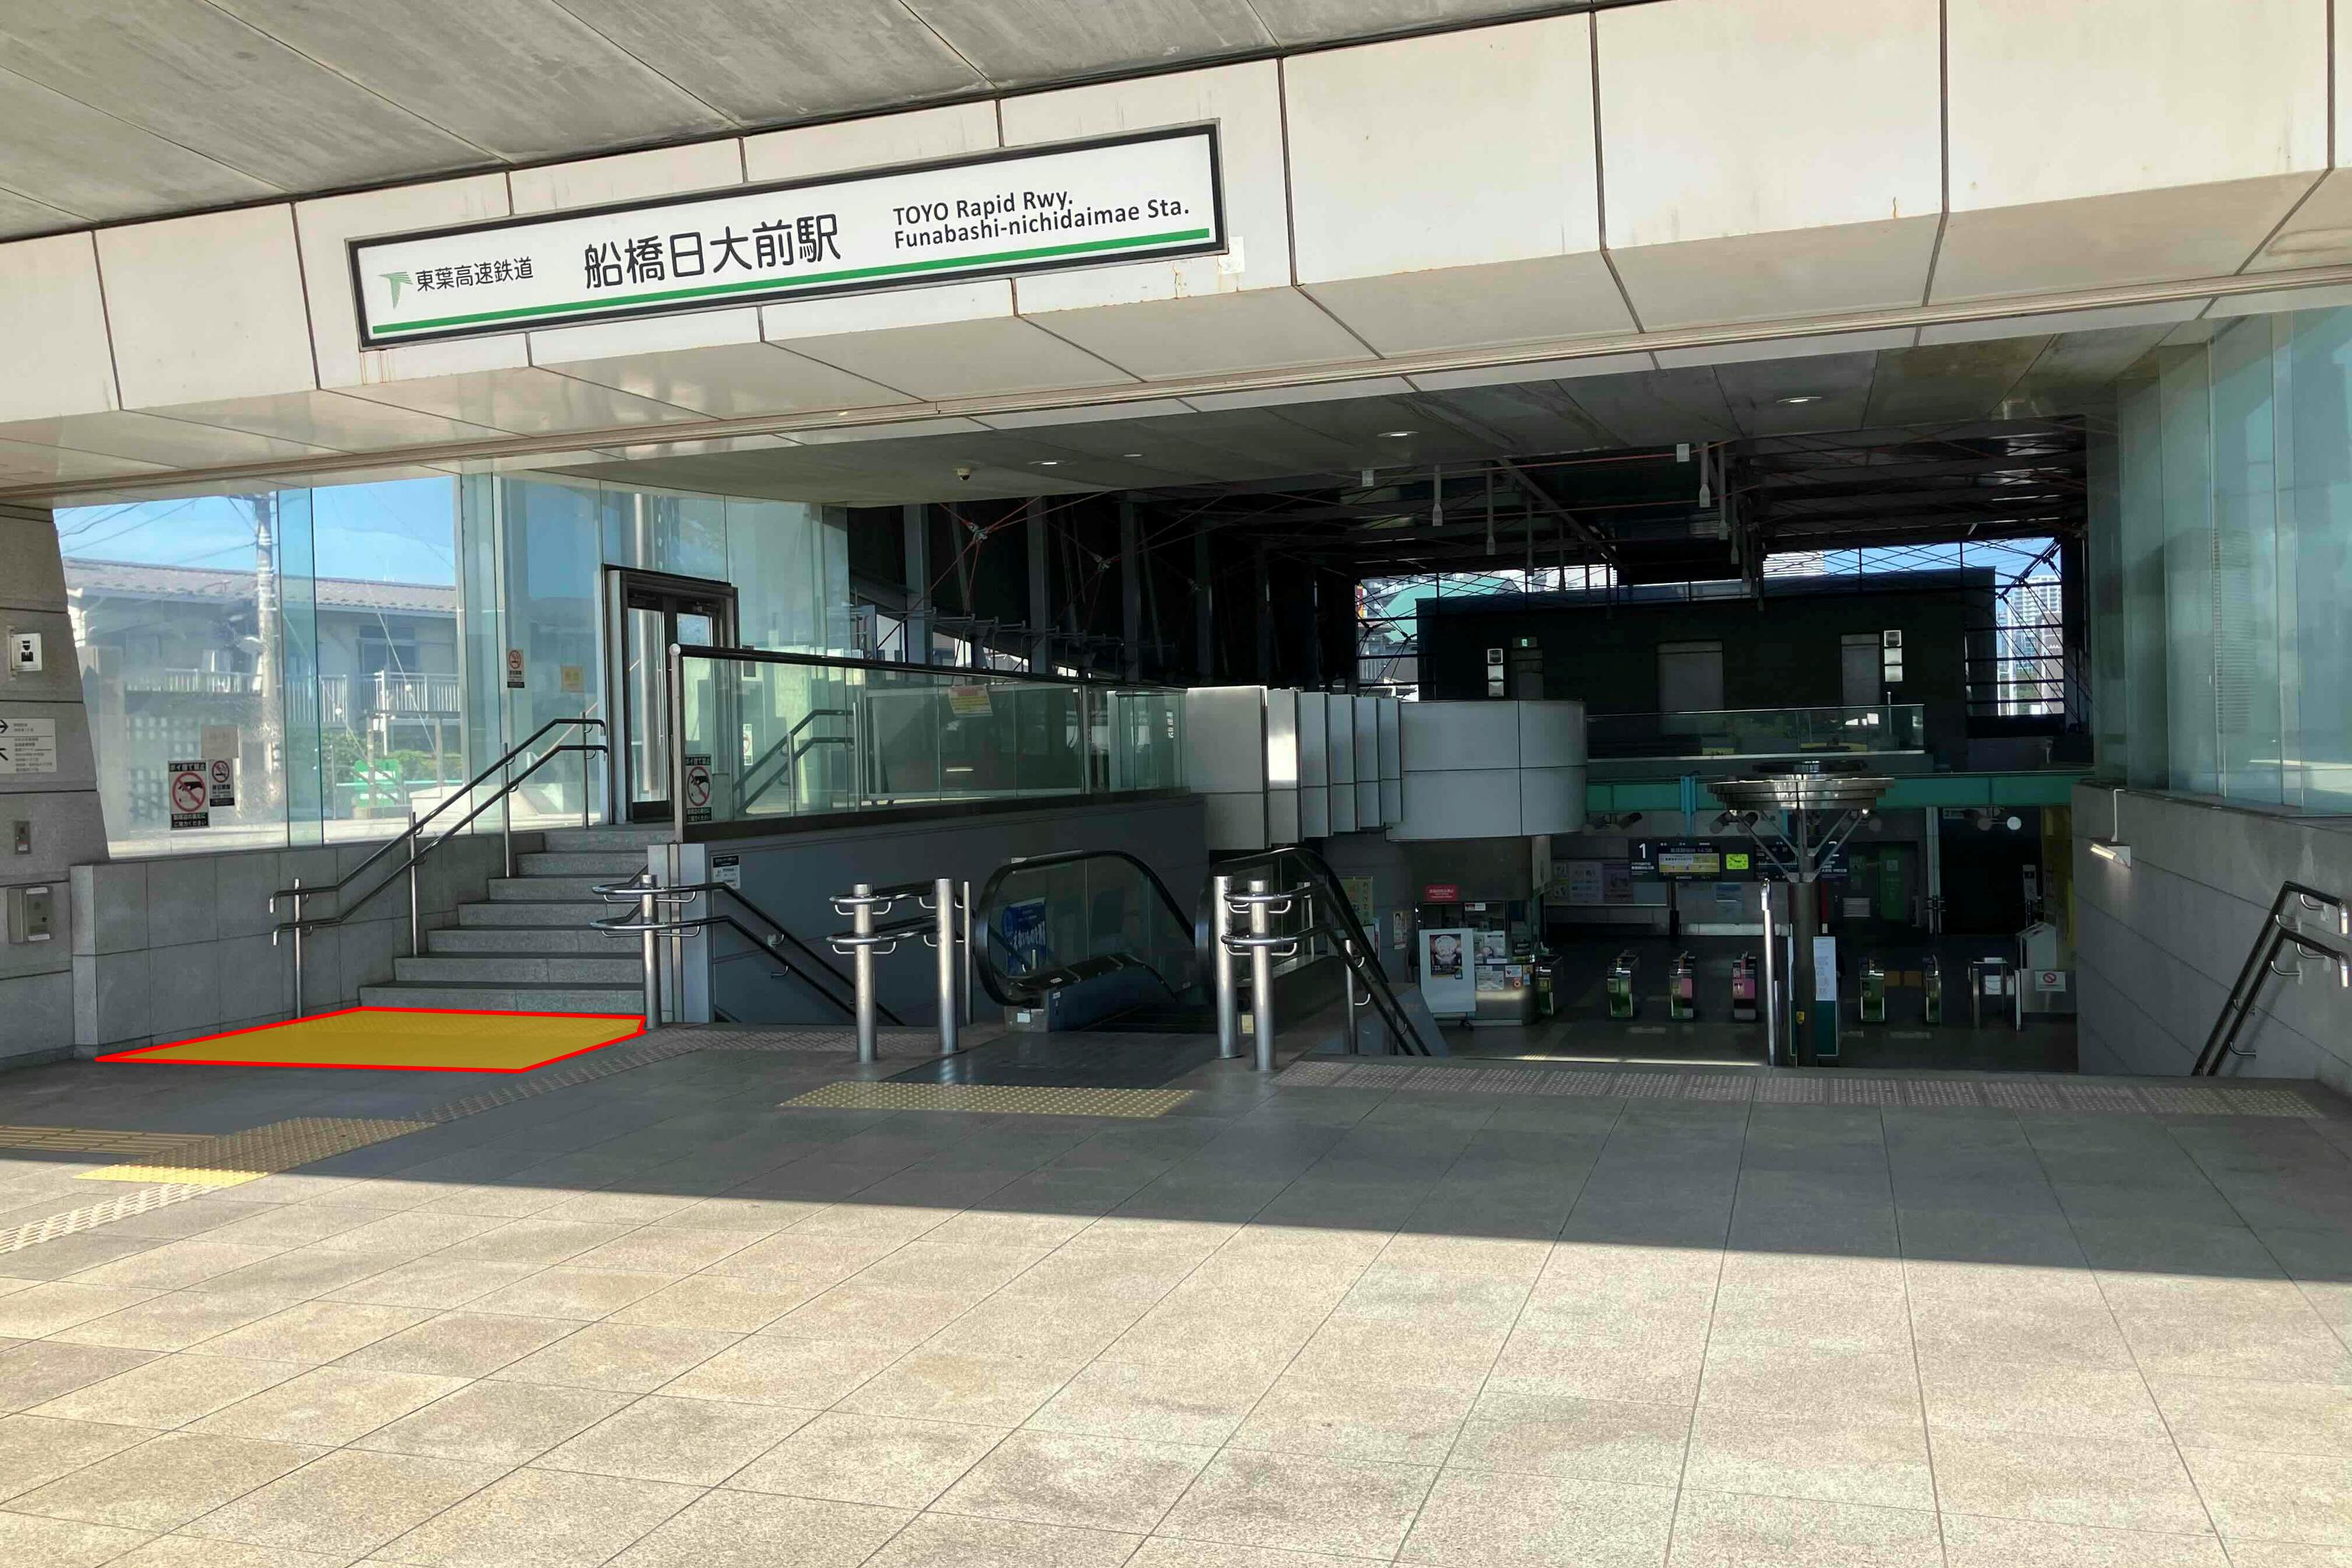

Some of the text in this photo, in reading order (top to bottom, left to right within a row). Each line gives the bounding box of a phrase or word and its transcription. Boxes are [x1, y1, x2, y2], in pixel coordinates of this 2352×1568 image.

[893, 190, 1073, 225] TOYO Rapid Rwy.
[894, 198, 1189, 249] Funabashi-nichidaimae Sta.
[584, 212, 841, 289] 船橋日大前駅
[416, 256, 533, 292] 東葉高速鉄道
[1639, 842, 1646, 859] 1
